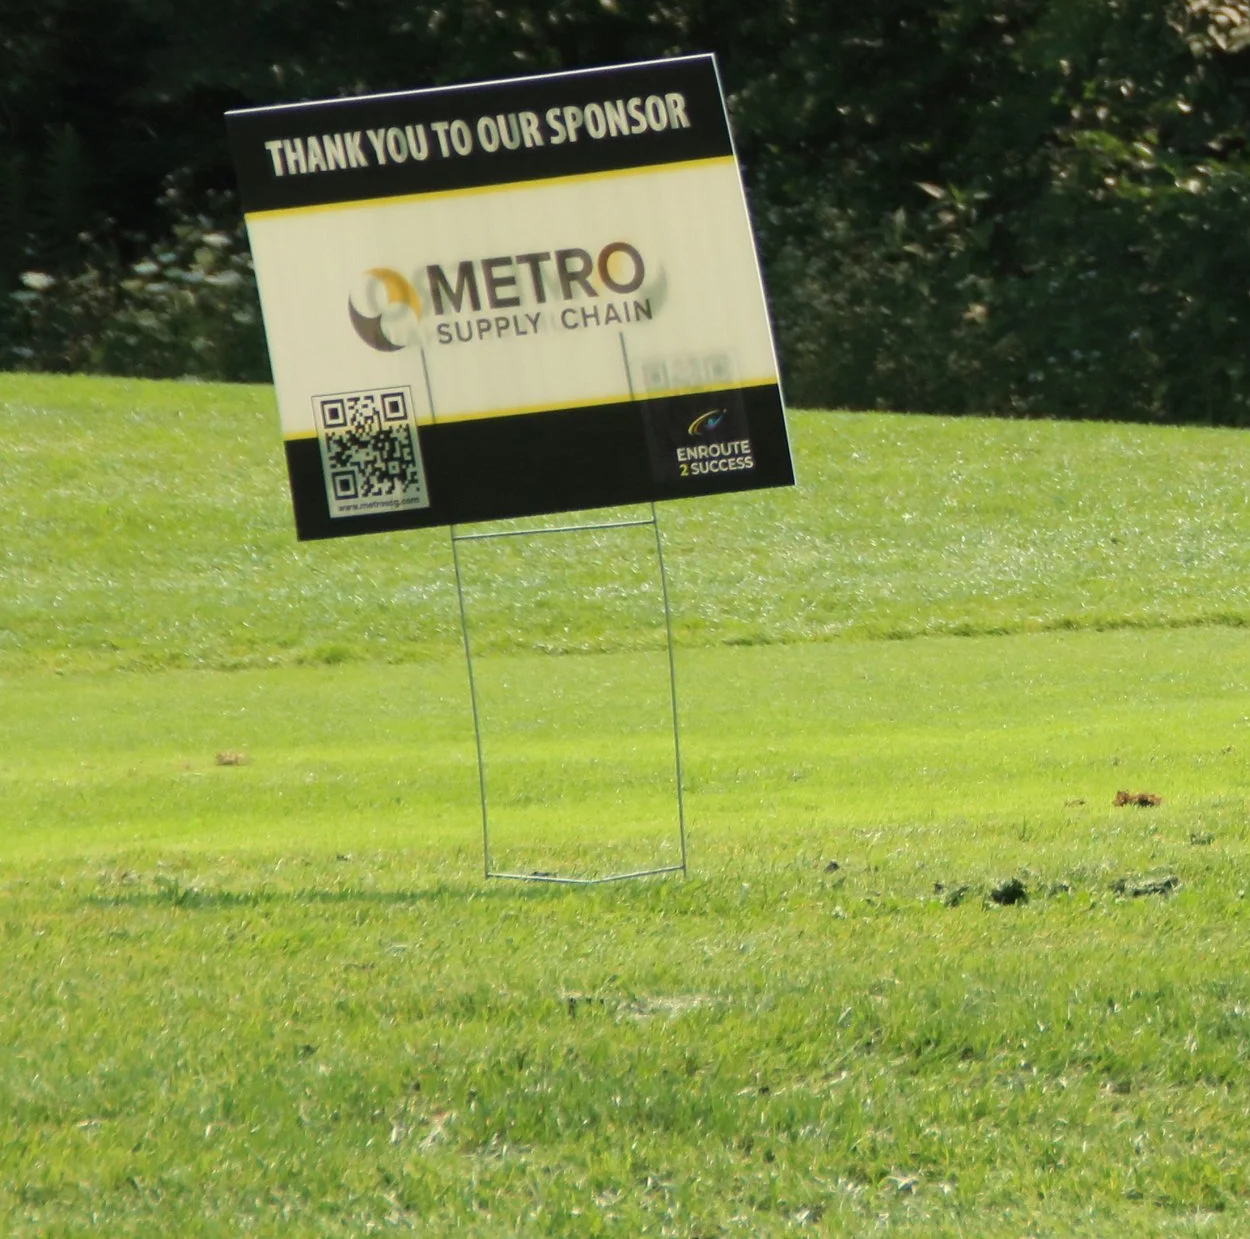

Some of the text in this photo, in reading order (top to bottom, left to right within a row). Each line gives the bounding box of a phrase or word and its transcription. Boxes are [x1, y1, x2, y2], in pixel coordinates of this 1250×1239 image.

[266, 92, 691, 176] THANK YOU TO OUR SPONSOR
[426, 242, 645, 315] METRO
[436, 299, 653, 344] SUPPLY CHAIN
[676, 440, 751, 462] ENROUTE
[680, 456, 754, 476] 2 SUCCESS
